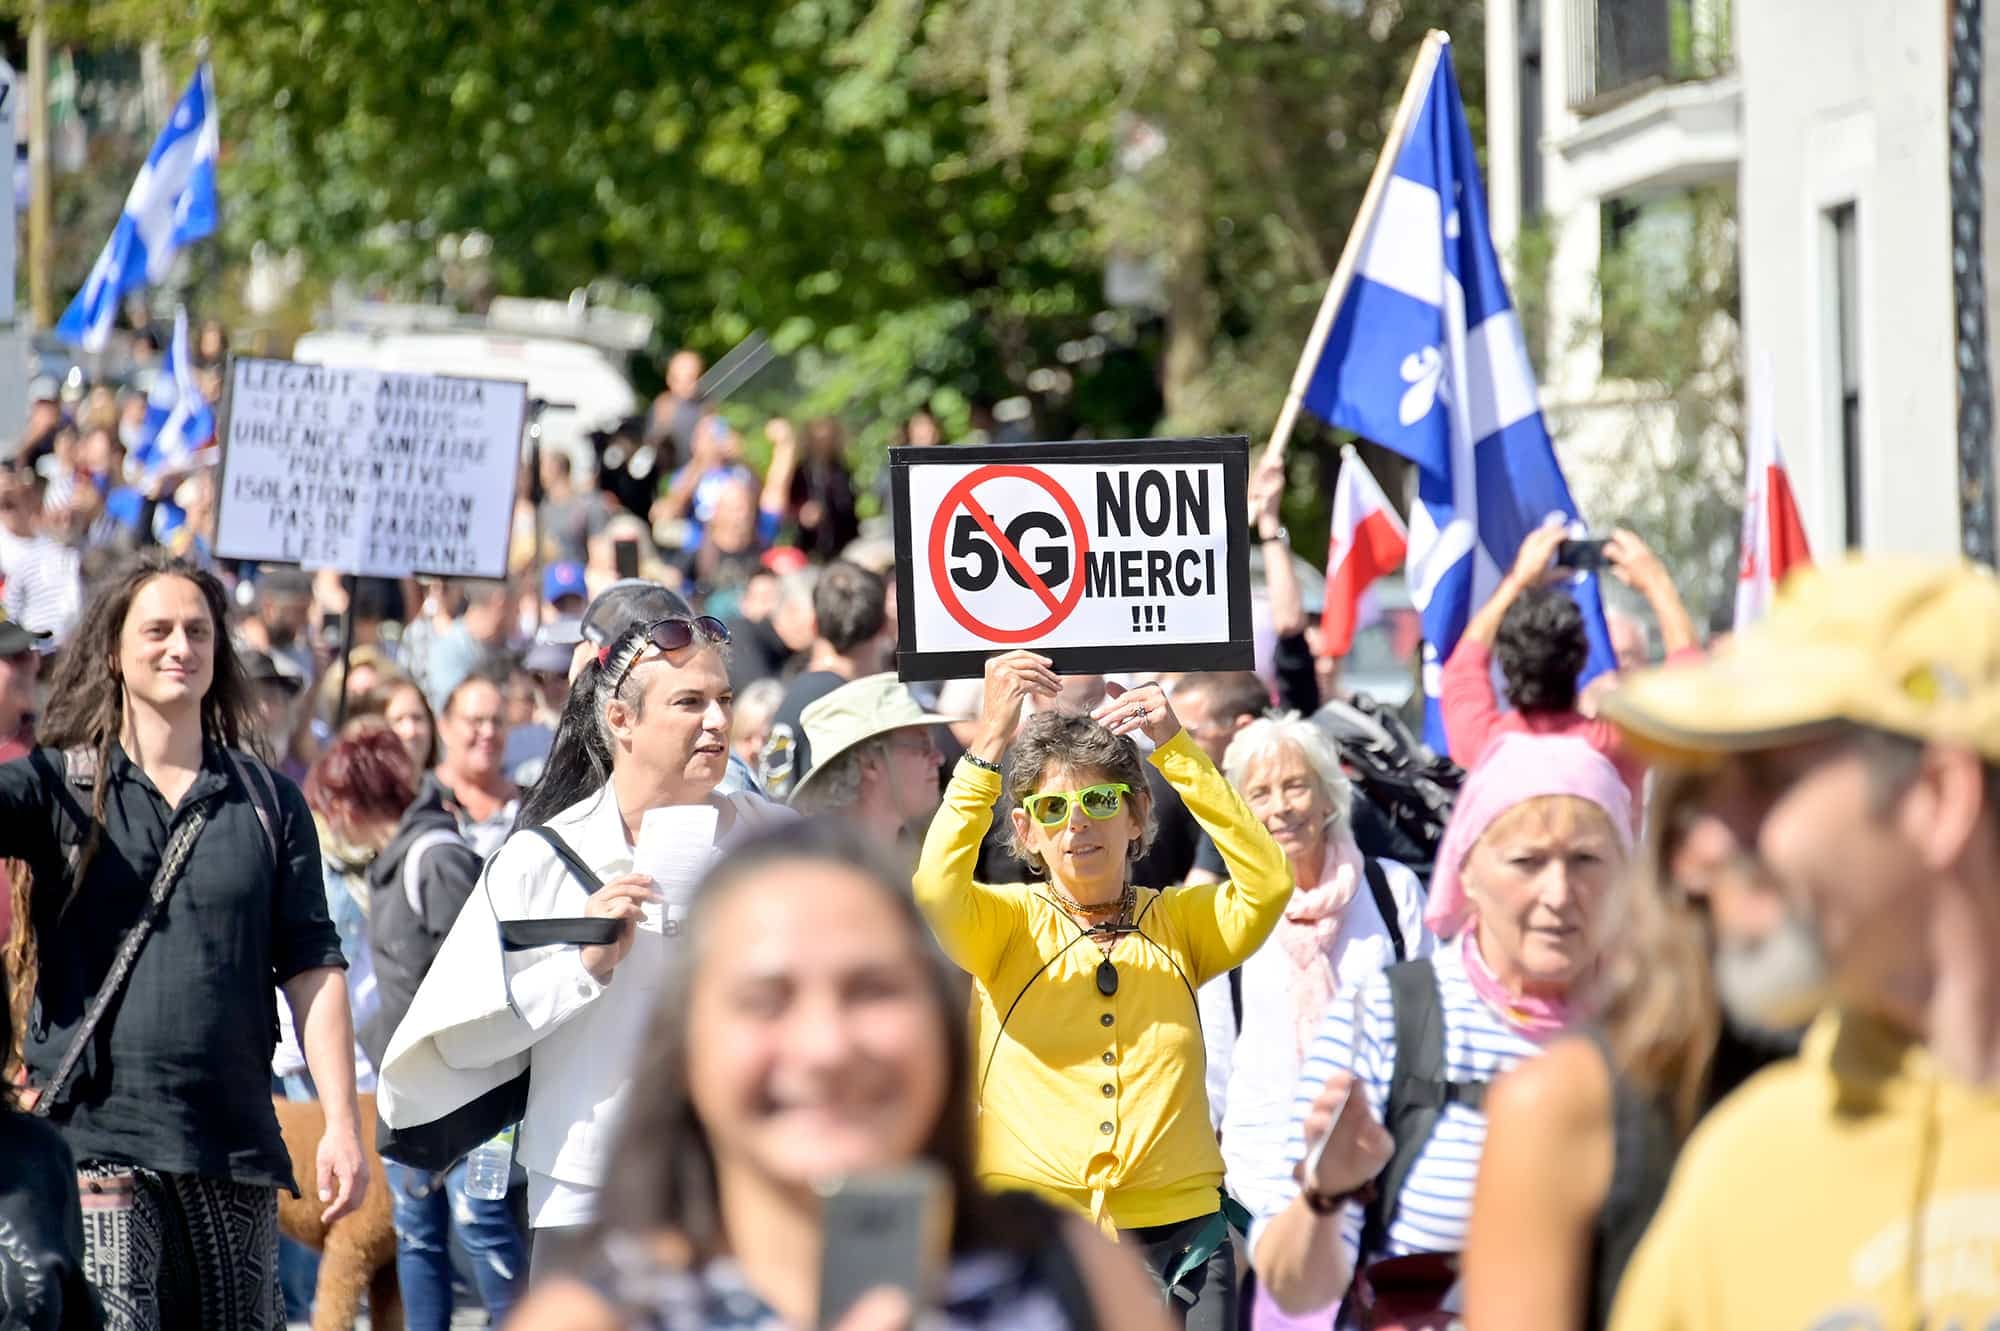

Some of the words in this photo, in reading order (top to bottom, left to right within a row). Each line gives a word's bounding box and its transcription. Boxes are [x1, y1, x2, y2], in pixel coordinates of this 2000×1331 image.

[1096, 469, 1211, 538] NON
[950, 511, 1070, 592] 5G
[1085, 549, 1216, 598] MERCI
[1132, 605, 1167, 632] !!!
